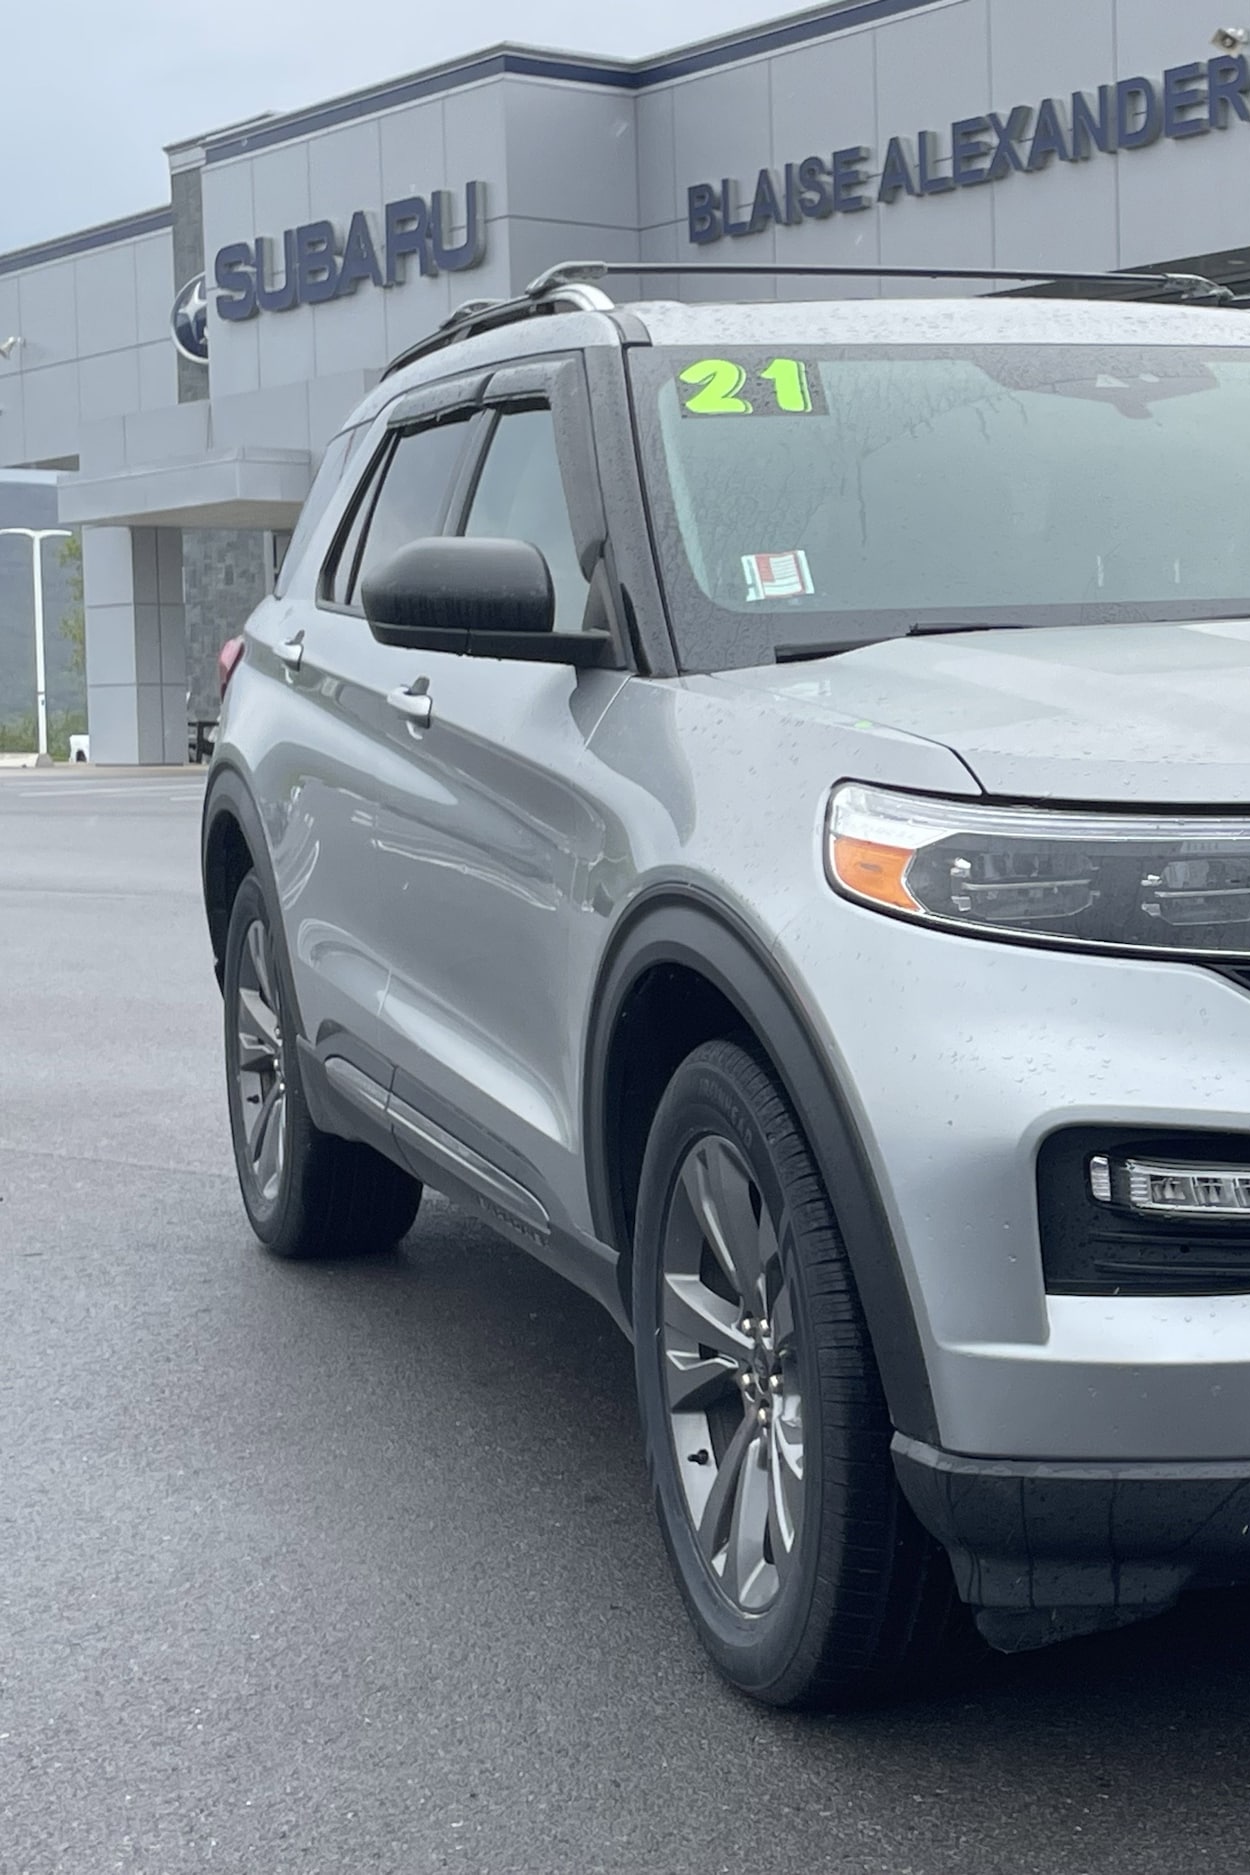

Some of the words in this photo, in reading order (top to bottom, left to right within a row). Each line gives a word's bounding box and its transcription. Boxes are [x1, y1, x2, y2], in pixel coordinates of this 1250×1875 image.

[687, 145, 872, 245] BLAISE
[214, 180, 486, 321] SUBARU
[679, 357, 813, 415] 21
